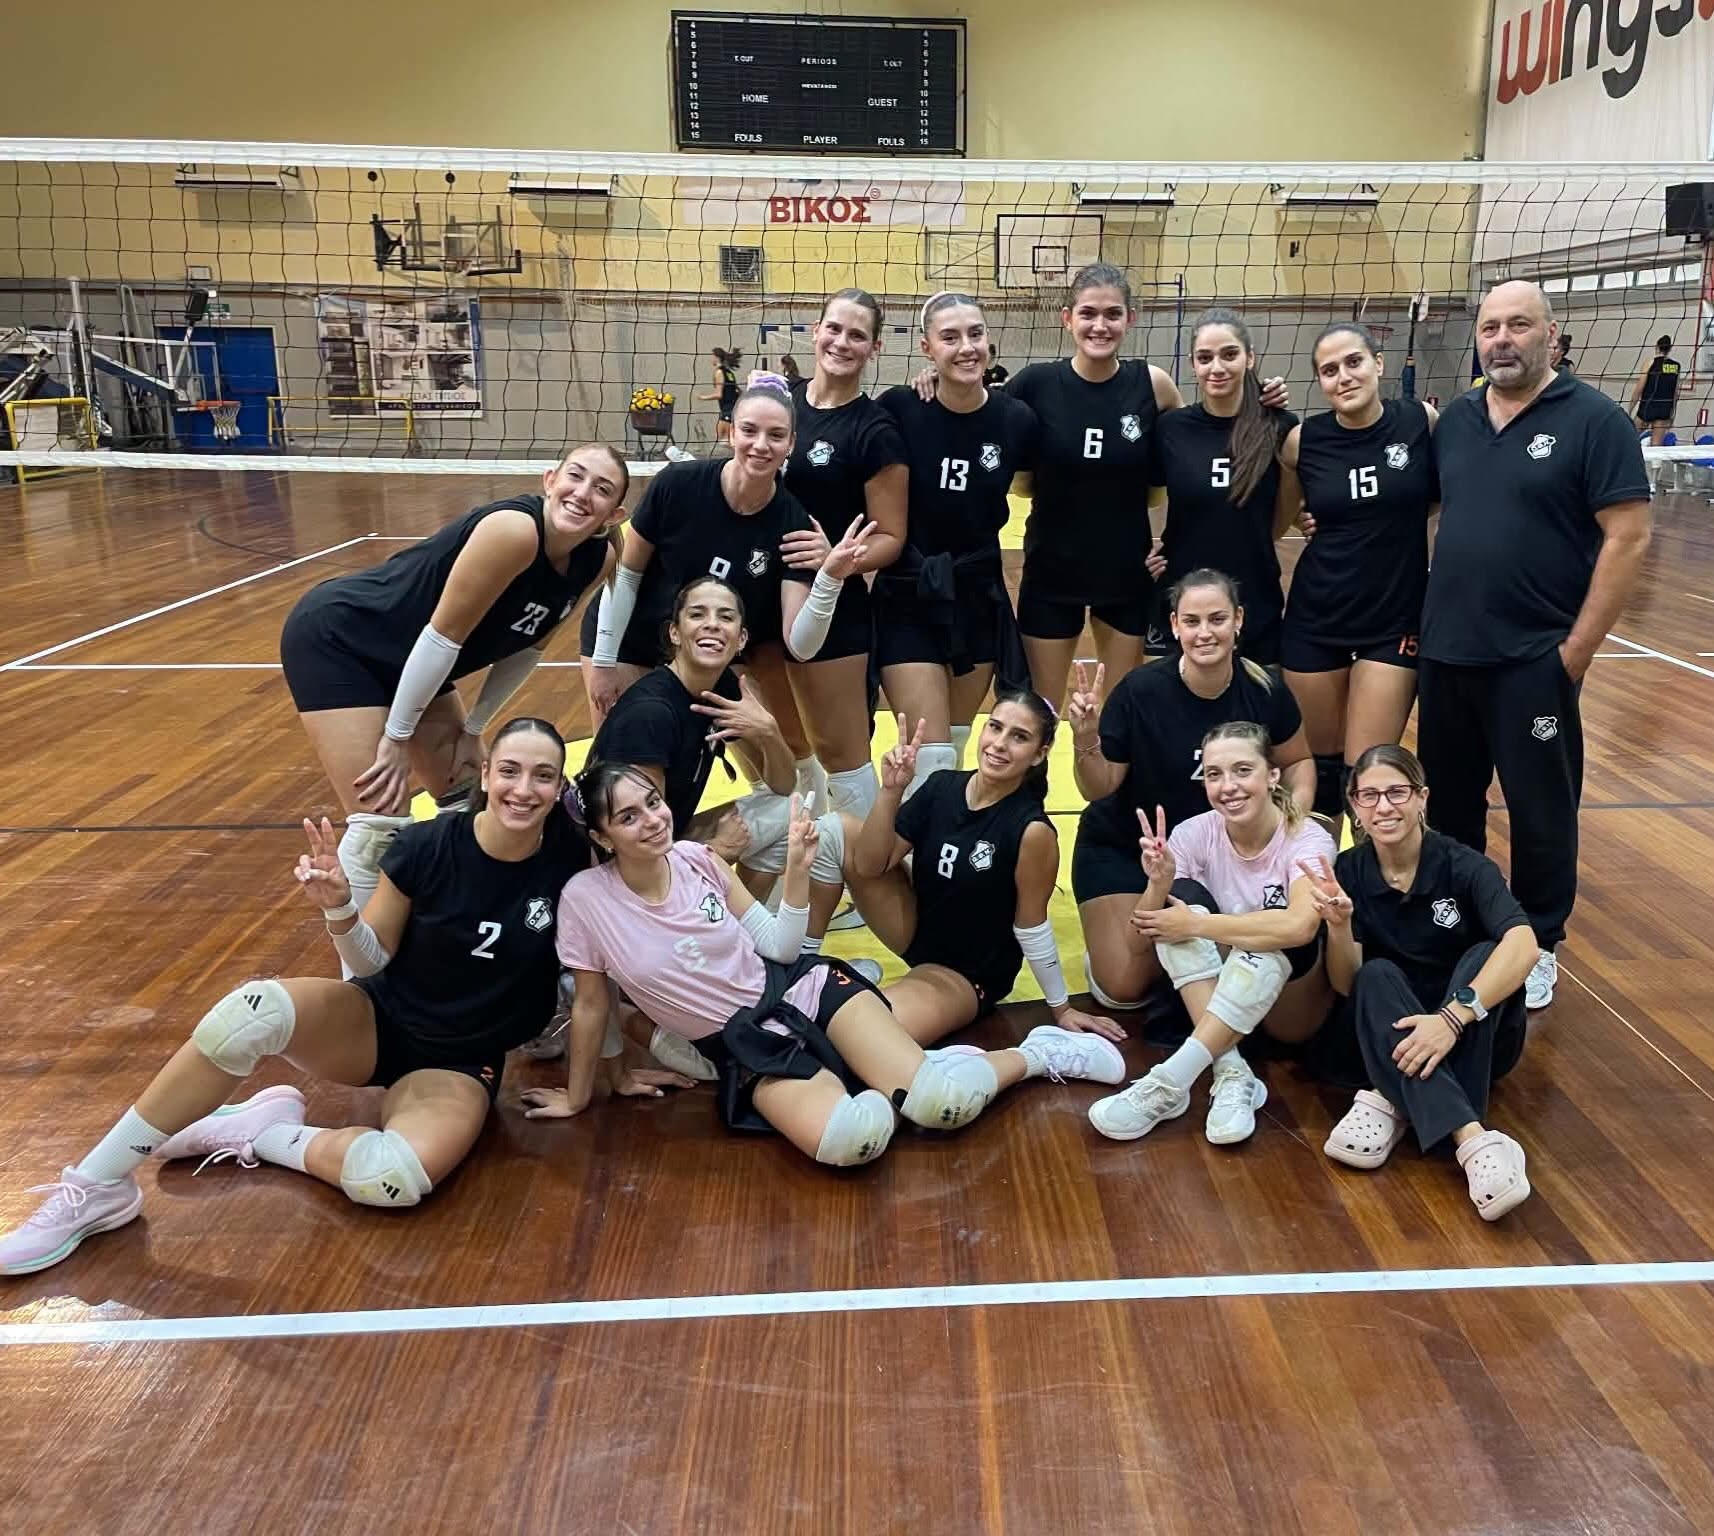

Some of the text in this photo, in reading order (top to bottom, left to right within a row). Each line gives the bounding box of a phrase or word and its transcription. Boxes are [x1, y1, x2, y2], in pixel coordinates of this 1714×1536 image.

[1497, 0, 1714, 104] wing
[689, 82, 698, 90] 10
[741, 94, 769, 103] HOME
[868, 97, 898, 107] GUEST
[690, 111, 699, 119] 13
[690, 121, 700, 129] 14
[691, 131, 700, 139] 15
[734, 133, 763, 143] FOULS
[803, 135, 838, 145] PLAYER
[877, 137, 905, 146] FOULS
[770, 196, 872, 223] ΒΙΚΟΣ
[1083, 427, 1104, 459] 6
[939, 456, 970, 492] 13
[1211, 457, 1231, 488] 5
[1348, 465, 1379, 500] 15
[510, 602, 550, 636] 23
[1398, 635, 1419, 657] 15
[938, 842, 960, 879] 8
[471, 921, 502, 959] 2
